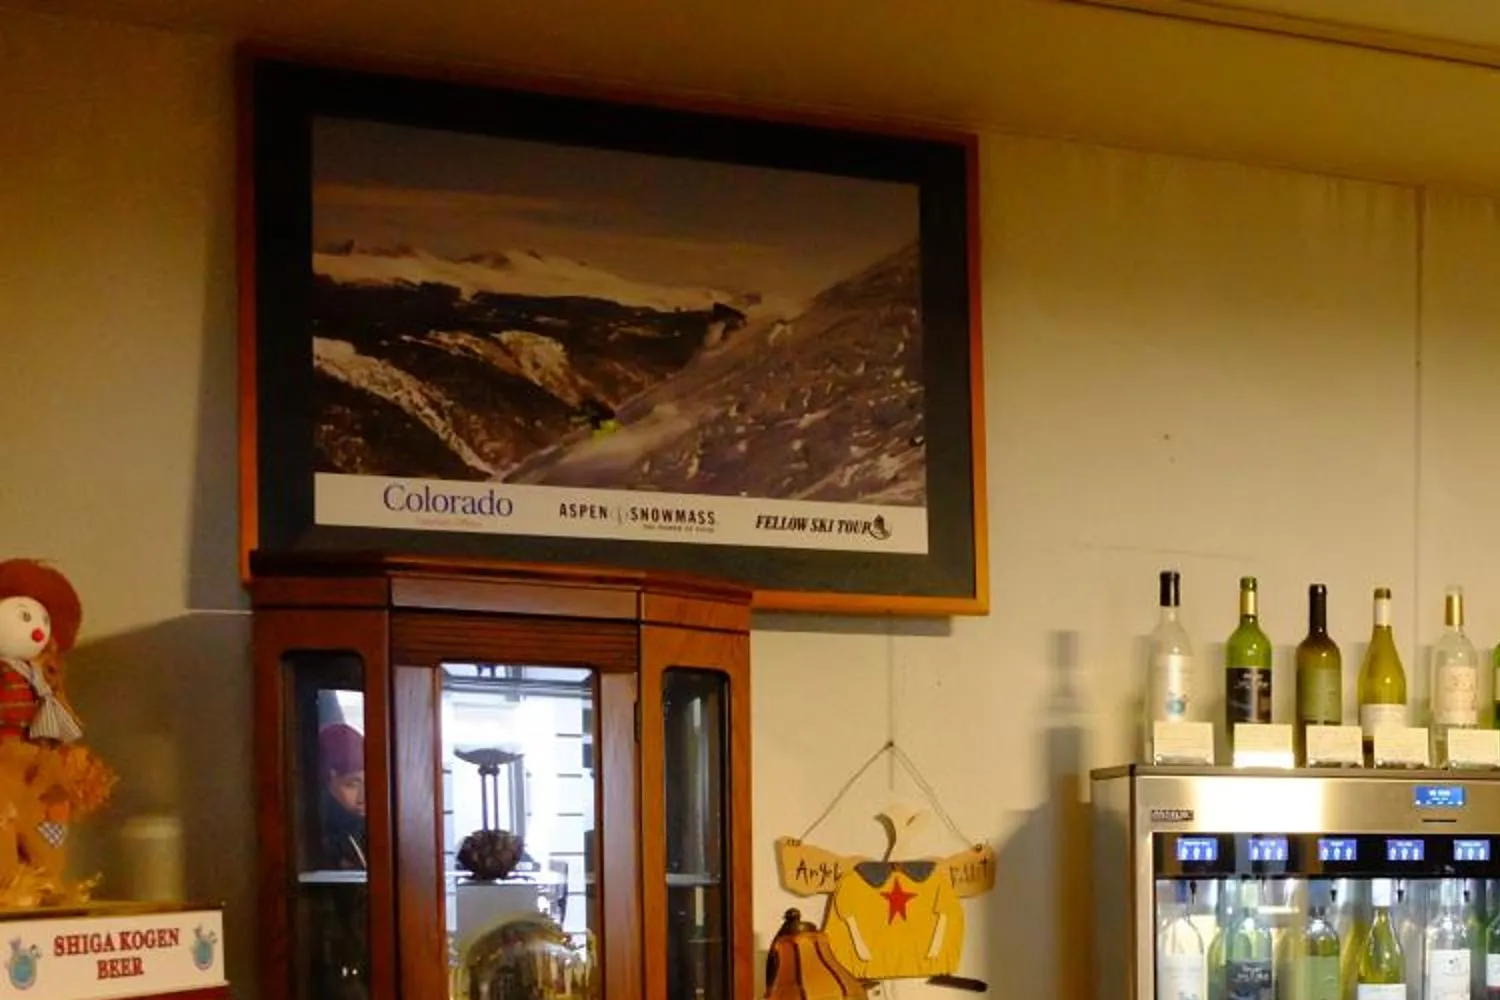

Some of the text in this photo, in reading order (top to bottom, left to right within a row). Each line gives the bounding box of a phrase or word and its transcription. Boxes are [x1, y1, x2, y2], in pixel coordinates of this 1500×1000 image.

[383, 484, 514, 517] Colorado
[559, 502, 715, 525] ASPEN SNOWMASS
[755, 515, 871, 535] FELLOW SKI TOUR
[53, 927, 181, 957] SHIGA KOGEN
[96, 957, 145, 980] BEER
